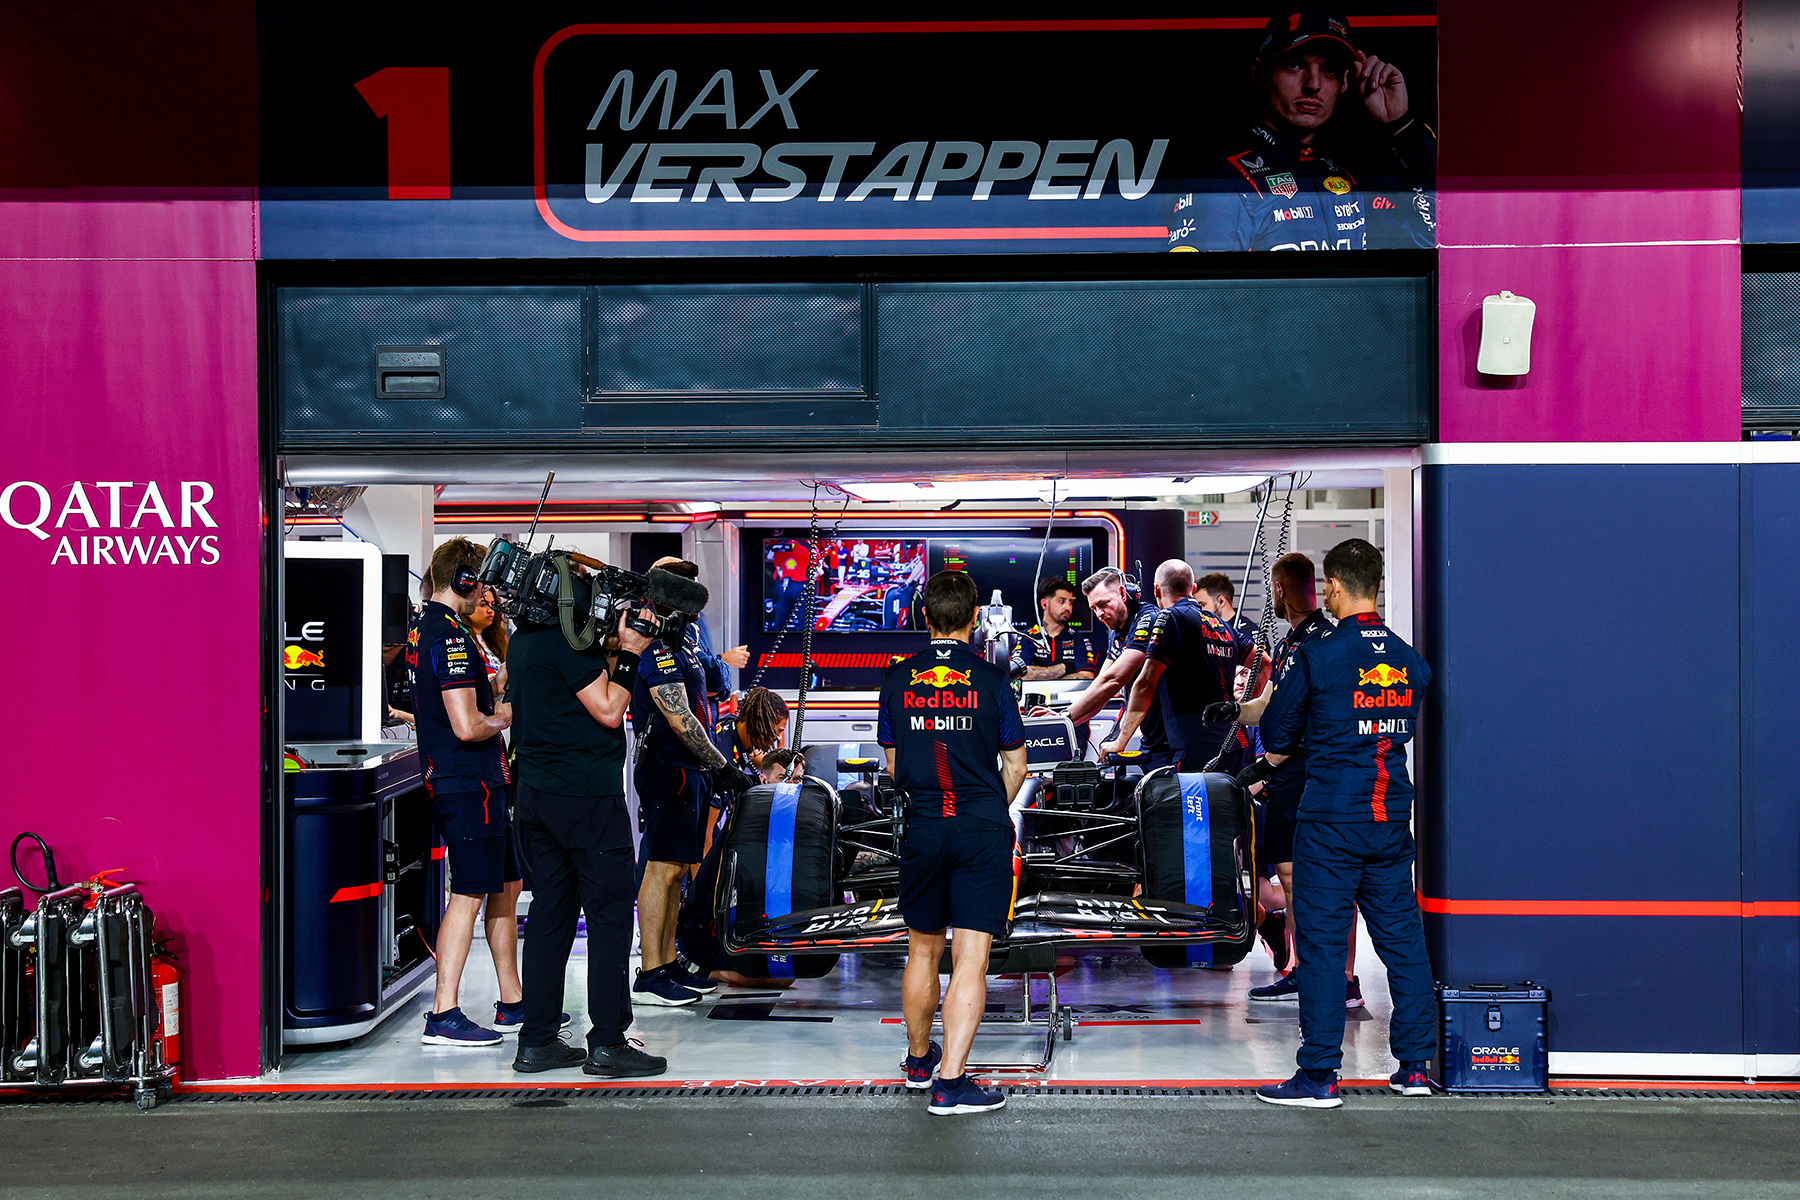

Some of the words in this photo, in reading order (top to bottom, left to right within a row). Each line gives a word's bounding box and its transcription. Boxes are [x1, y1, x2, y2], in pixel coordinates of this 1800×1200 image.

[586, 69, 818, 131] MAX
[354, 67, 450, 200] 1
[585, 139, 1170, 204] VERSTAPPEN
[1268, 174, 1293, 187] TAG
[1273, 207, 1303, 222] Mobil
[1335, 201, 1360, 217] BYBIT
[0, 481, 217, 540] QATAR
[51, 535, 220, 566] AIRWAYS
[446, 637, 465, 646] Mobil
[903, 690, 940, 708] Red
[942, 690, 978, 709] Bull
[1353, 689, 1385, 708] Red
[1387, 689, 1413, 707] Bull
[910, 715, 954, 730] Mobil
[956, 716, 972, 730] 1
[1358, 719, 1395, 734] Mobil
[1024, 737, 1065, 748] RACLE
[1187, 796, 1195, 814] Left
[1194, 796, 1203, 822] Front
[1471, 1047, 1520, 1055] ORACLE
